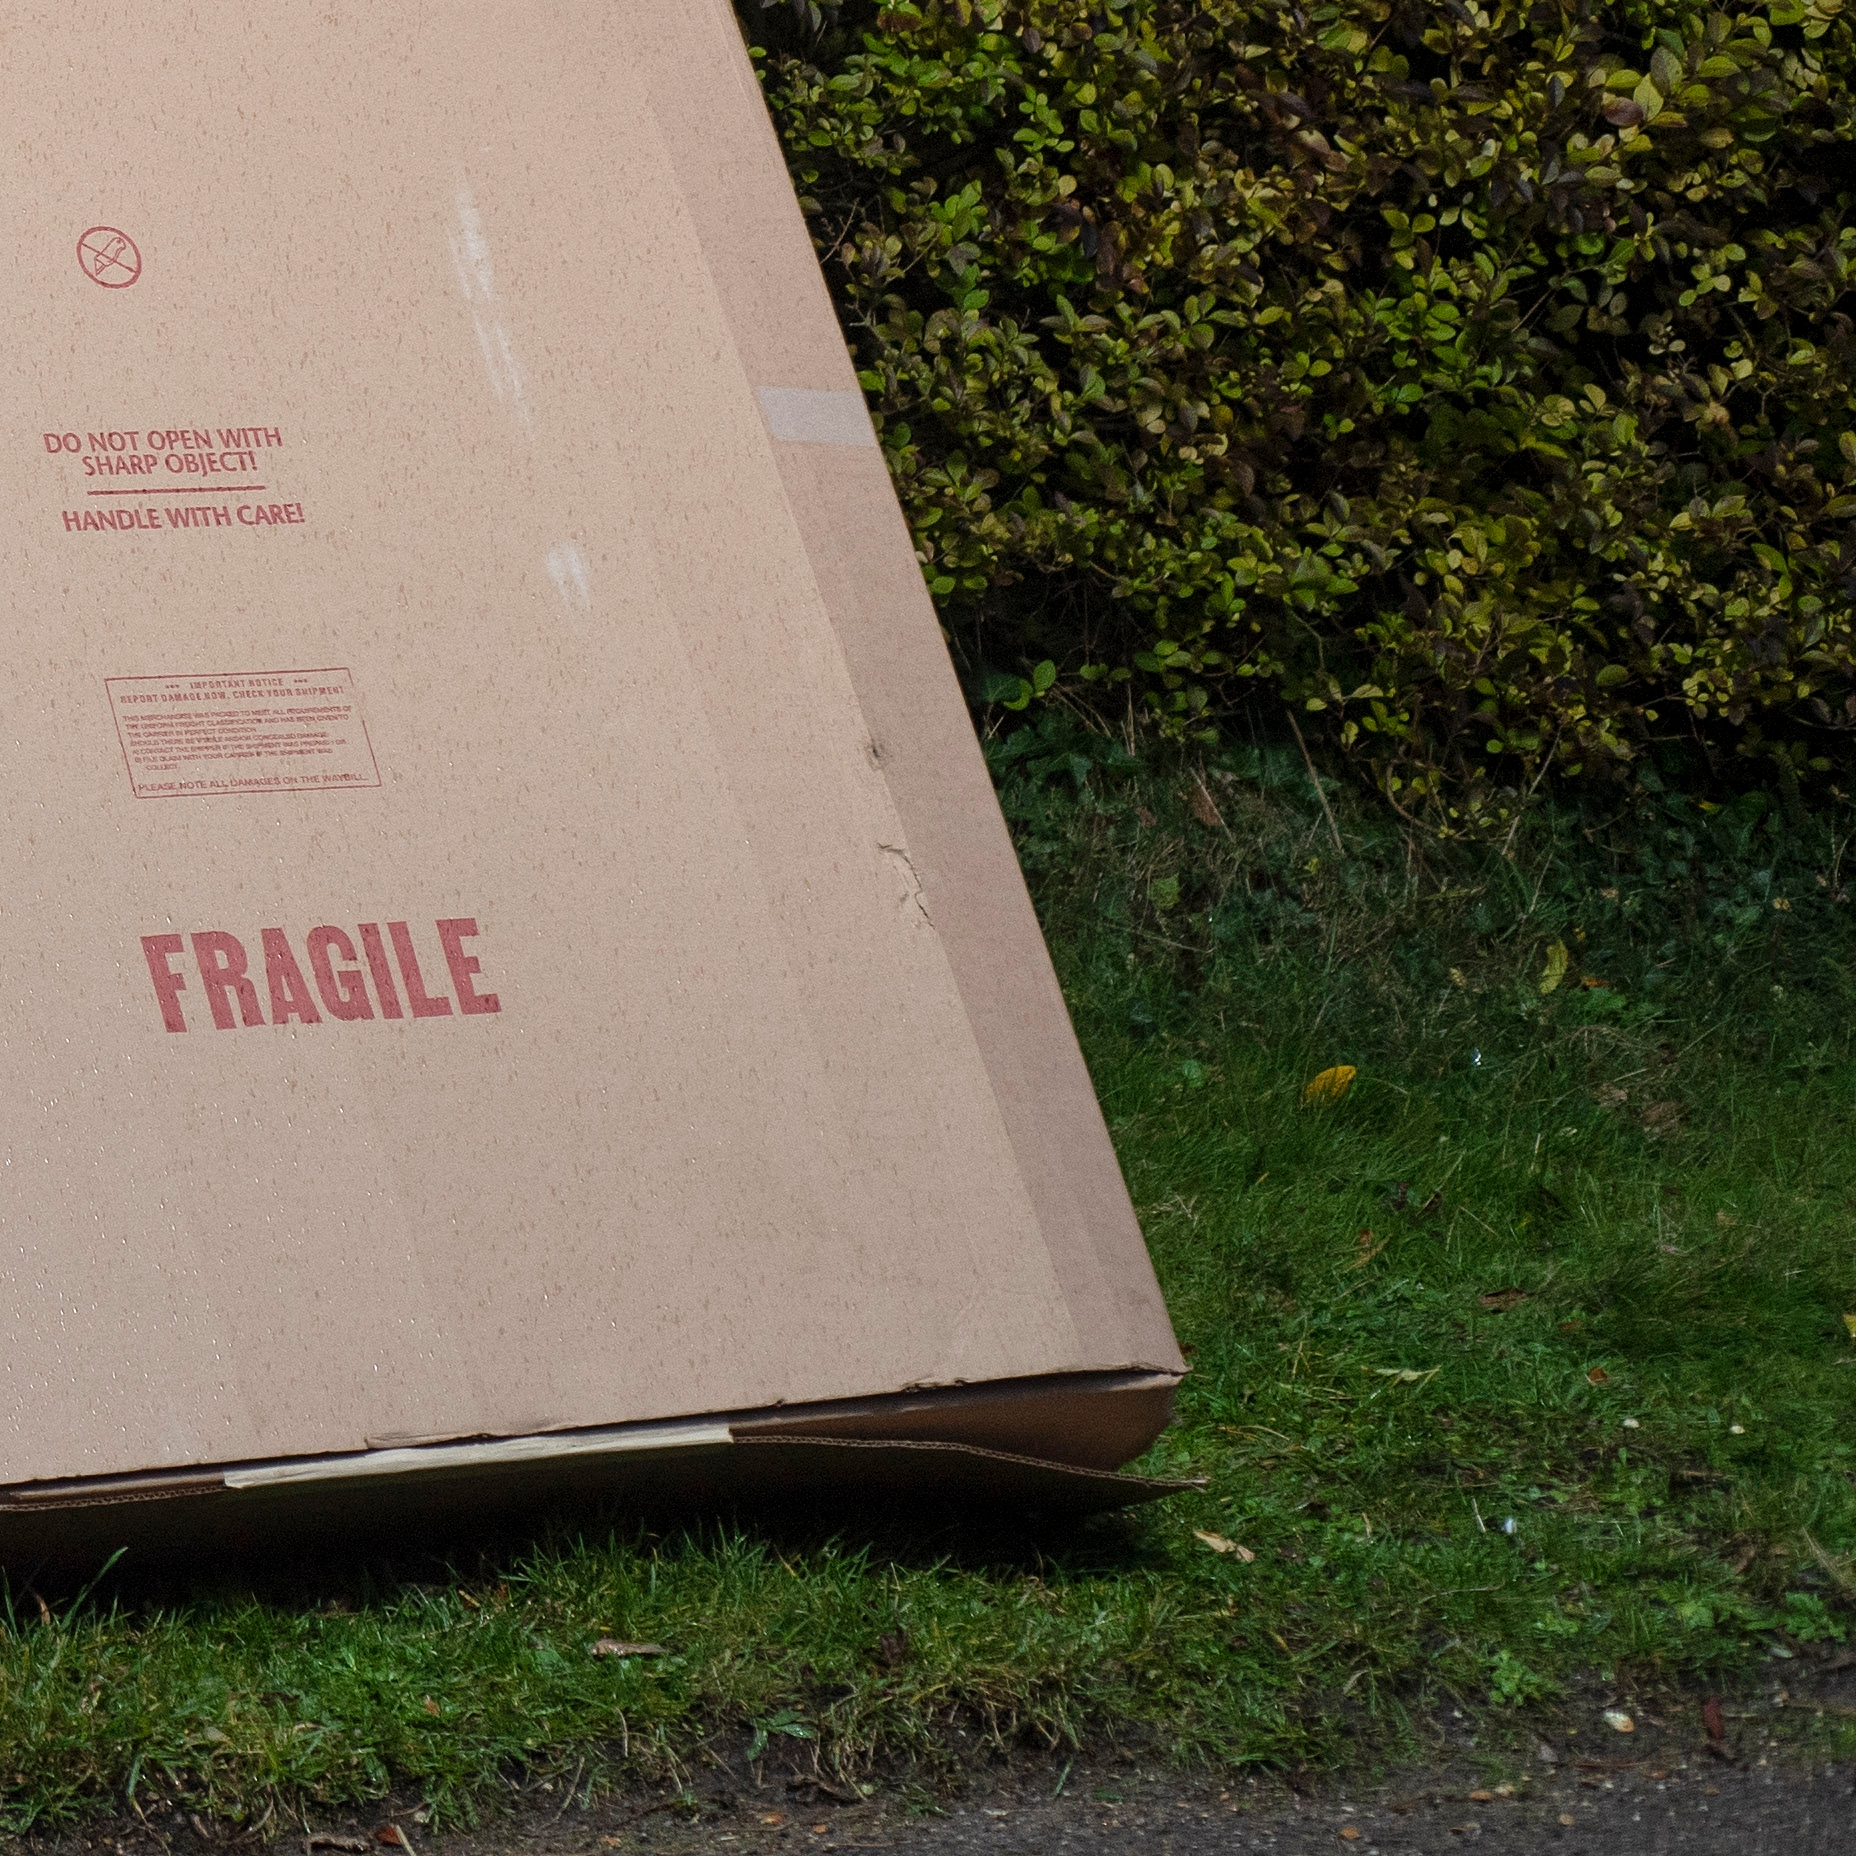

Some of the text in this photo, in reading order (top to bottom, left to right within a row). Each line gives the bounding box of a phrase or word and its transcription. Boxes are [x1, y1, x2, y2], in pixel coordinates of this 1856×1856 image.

[43, 427, 283, 453] DO NOT OPEN WITH
[82, 451, 258, 476] SHARP OBJECT!
[62, 502, 306, 531] HANDLE WITH CARE!
[119, 694, 158, 703] REPORT
[160, 692, 202, 702] DAMAGE
[232, 689, 264, 698] CHECK
[266, 688, 292, 697] YOUR
[295, 686, 344, 695] SHIPMENT
[189, 678, 283, 689] IMPORTANT NOTICE
[138, 782, 177, 791] PLEASE
[178, 781, 207, 789] NOTE
[208, 779, 229, 788] ALL
[229, 777, 280, 787] DAMAGES
[282, 776, 298, 784] ON
[299, 775, 320, 783] THE
[140, 917, 502, 1034] FRAGILE
